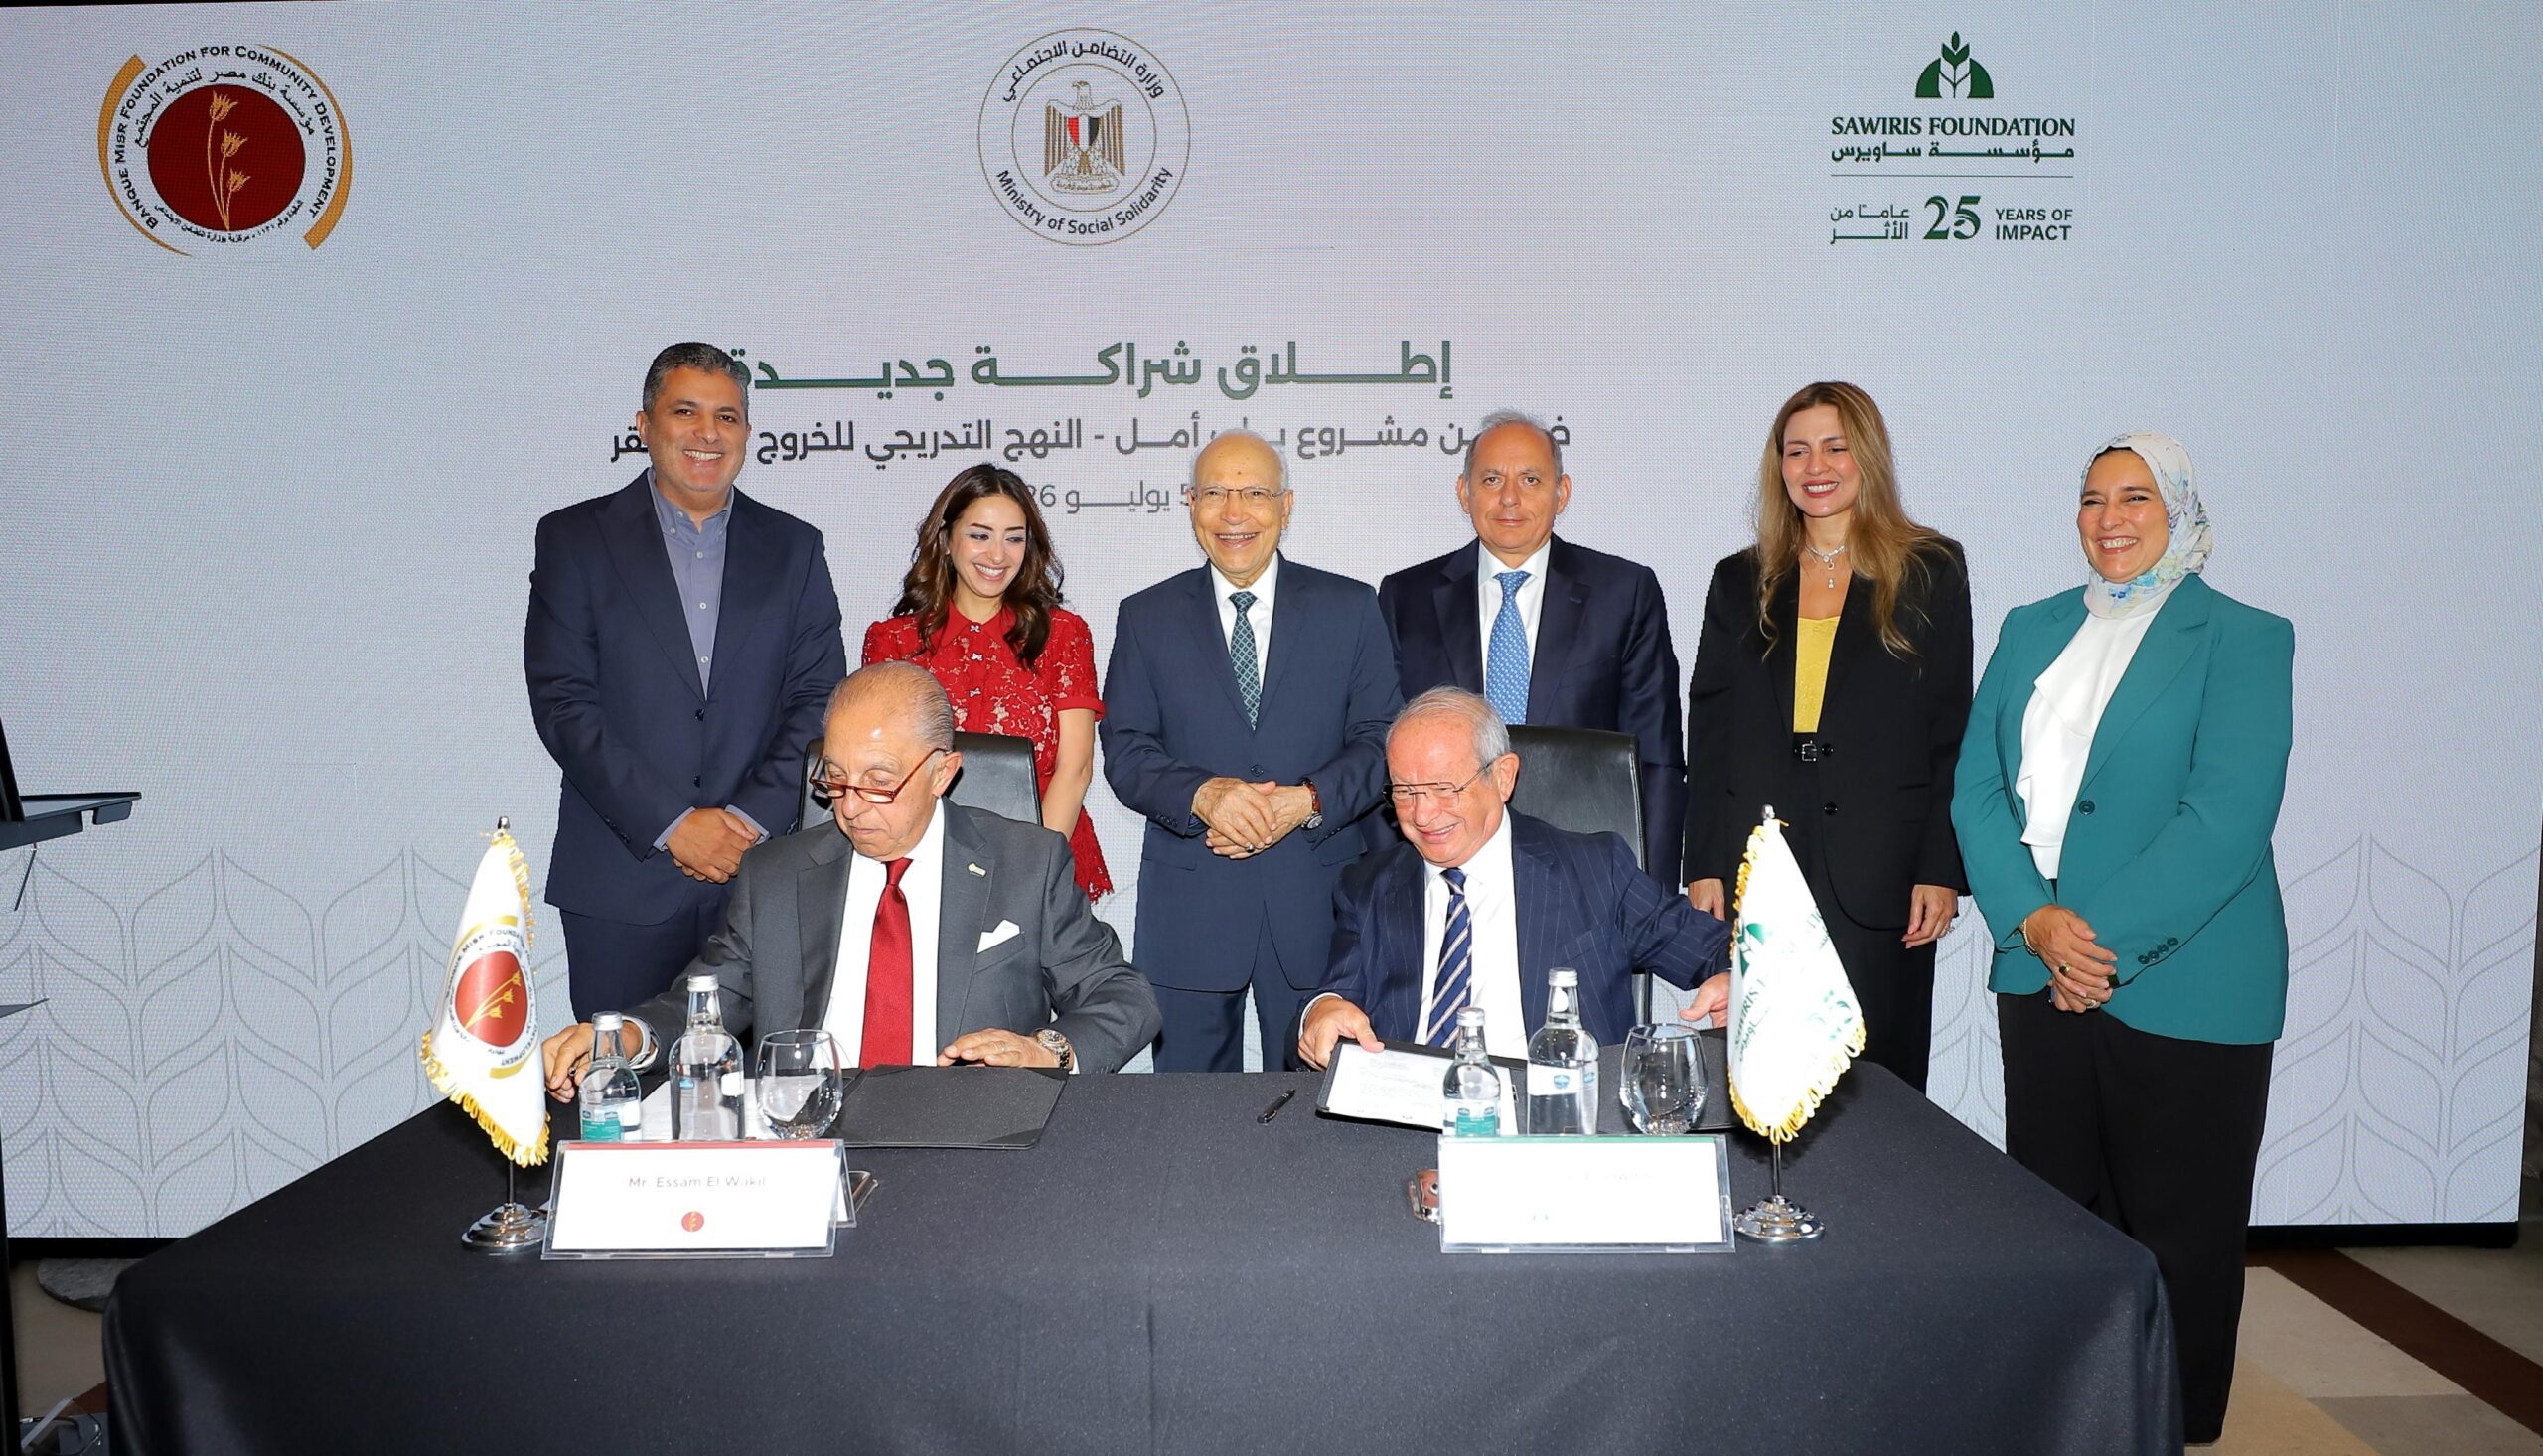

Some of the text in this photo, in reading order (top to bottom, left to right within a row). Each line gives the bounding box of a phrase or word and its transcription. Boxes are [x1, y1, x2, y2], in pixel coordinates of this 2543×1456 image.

[1003, 40, 1164, 102] وزارة التضامن الاجتماعي
[134, 67, 315, 148] مؤسسة بنك مصر لتنمية المجتمع
[1831, 116, 2075, 137] SAWIRIS FOUNDATION
[115, 45, 337, 229] BANQUE MISR FOUNDATION FOR COMMUNITY DEVELOPMENT
[1831, 138, 2075, 163] مؤسسة ساويرس
[996, 167, 1174, 235] Ministry of Social Solidarity
[1830, 207, 1854, 221] من
[1923, 195, 1982, 240] 25
[1995, 208, 2074, 221] YEARS OF
[1830, 220, 1909, 245] الأثر
[1995, 225, 2073, 241] IMPACT
[970, 340, 1202, 398] شراكة
[1217, 340, 1454, 400] إطلاق
[756, 420, 855, 465] للخروج
[865, 418, 992, 470] التدريجي
[1002, 417, 1083, 461] النهج
[1115, 410, 1200, 455] أمل
[1296, 418, 1429, 460] مشروع
[1066, 480, 1170, 514] يوليو
[656, 1176, 702, 1188] Essam
[706, 1176, 719, 1187] El
